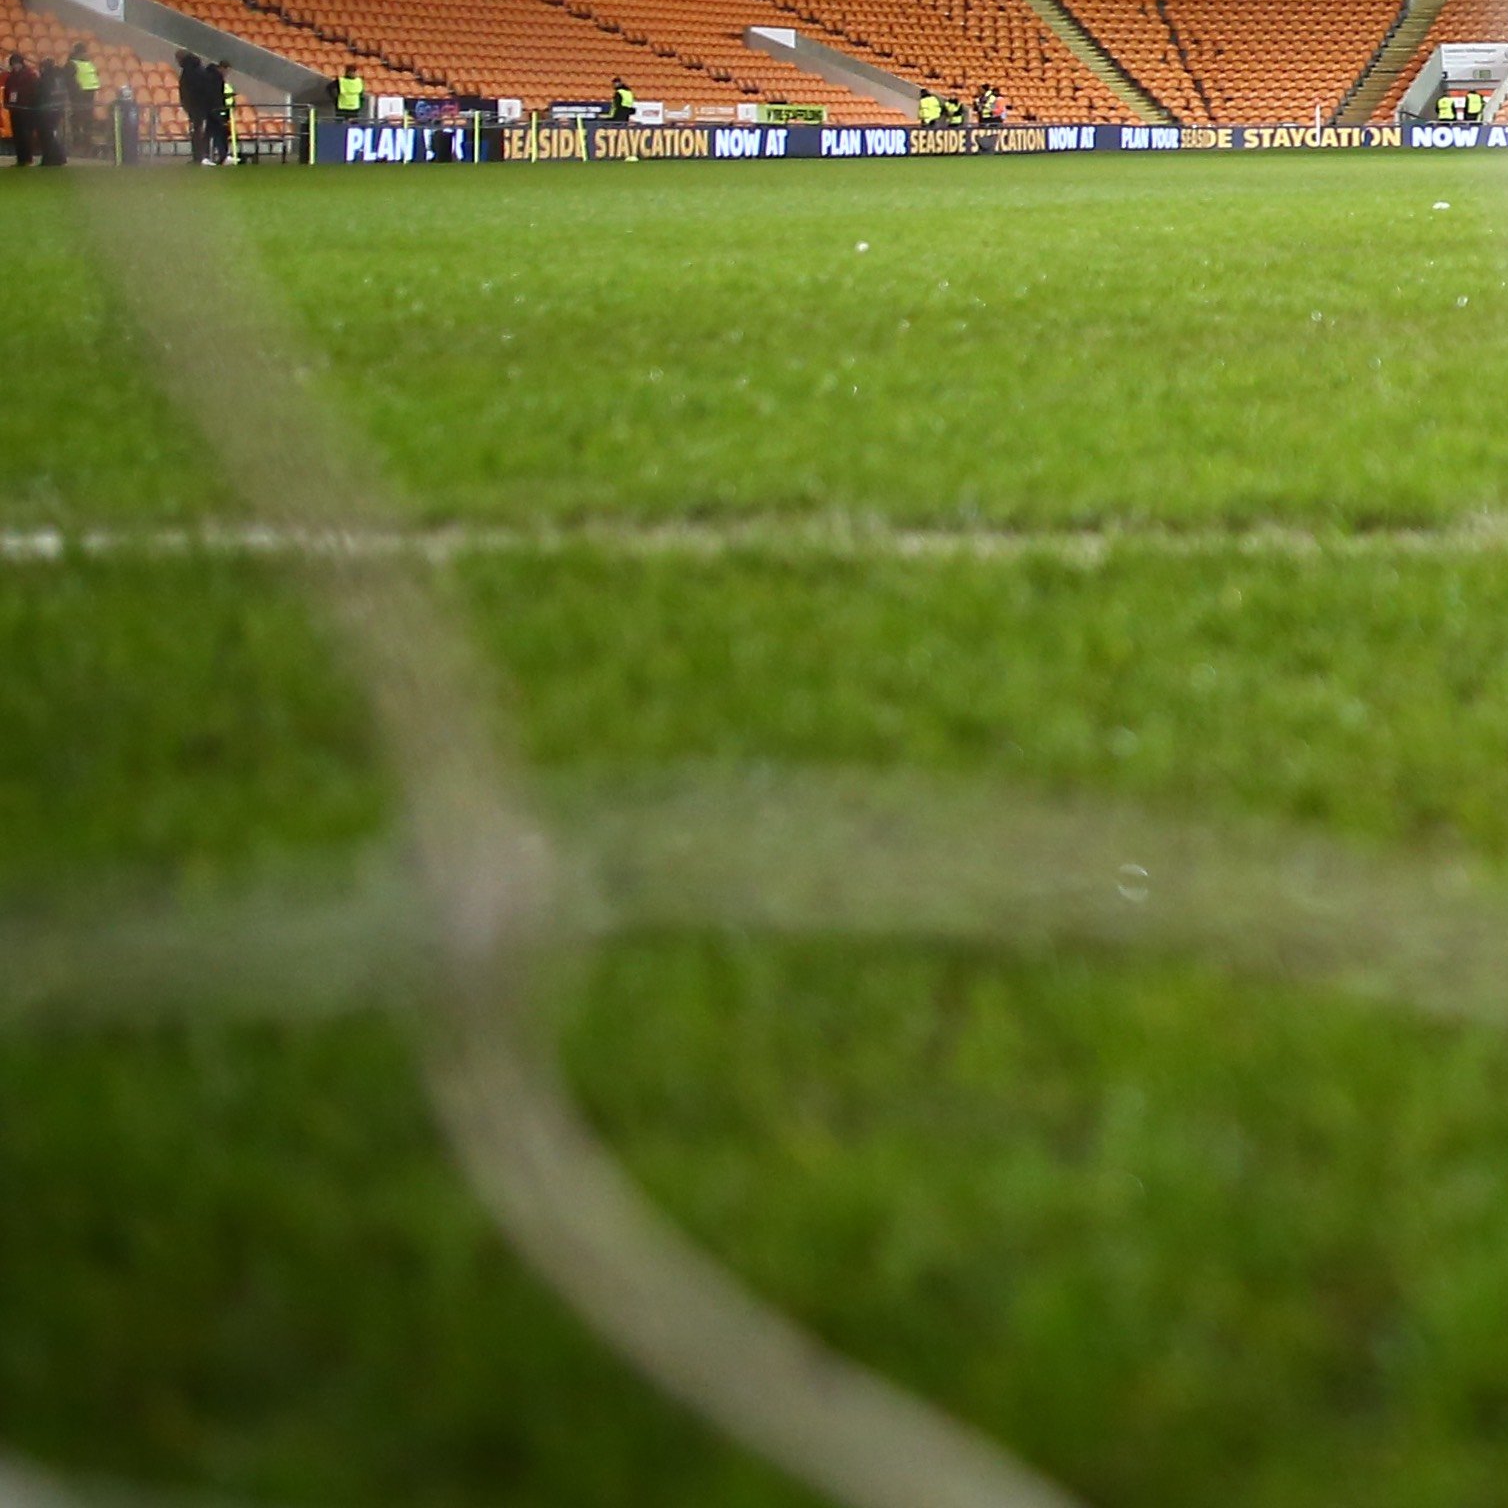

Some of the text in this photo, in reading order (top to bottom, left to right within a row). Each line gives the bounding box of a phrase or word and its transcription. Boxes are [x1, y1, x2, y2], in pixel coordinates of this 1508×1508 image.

[345, 127, 414, 162] PLAN
[594, 128, 709, 159] STAYCATION
[714, 128, 761, 157] NOW
[764, 128, 788, 156] AT
[820, 126, 1096, 156] PLAN YOUR SEASIDE SCATION NOW AT
[1120, 126, 1150, 149] PLAN
[1150, 127, 1180, 149] YOUR
[1243, 127, 1401, 149] STAYCATION
[1412, 126, 1480, 148] NOW
